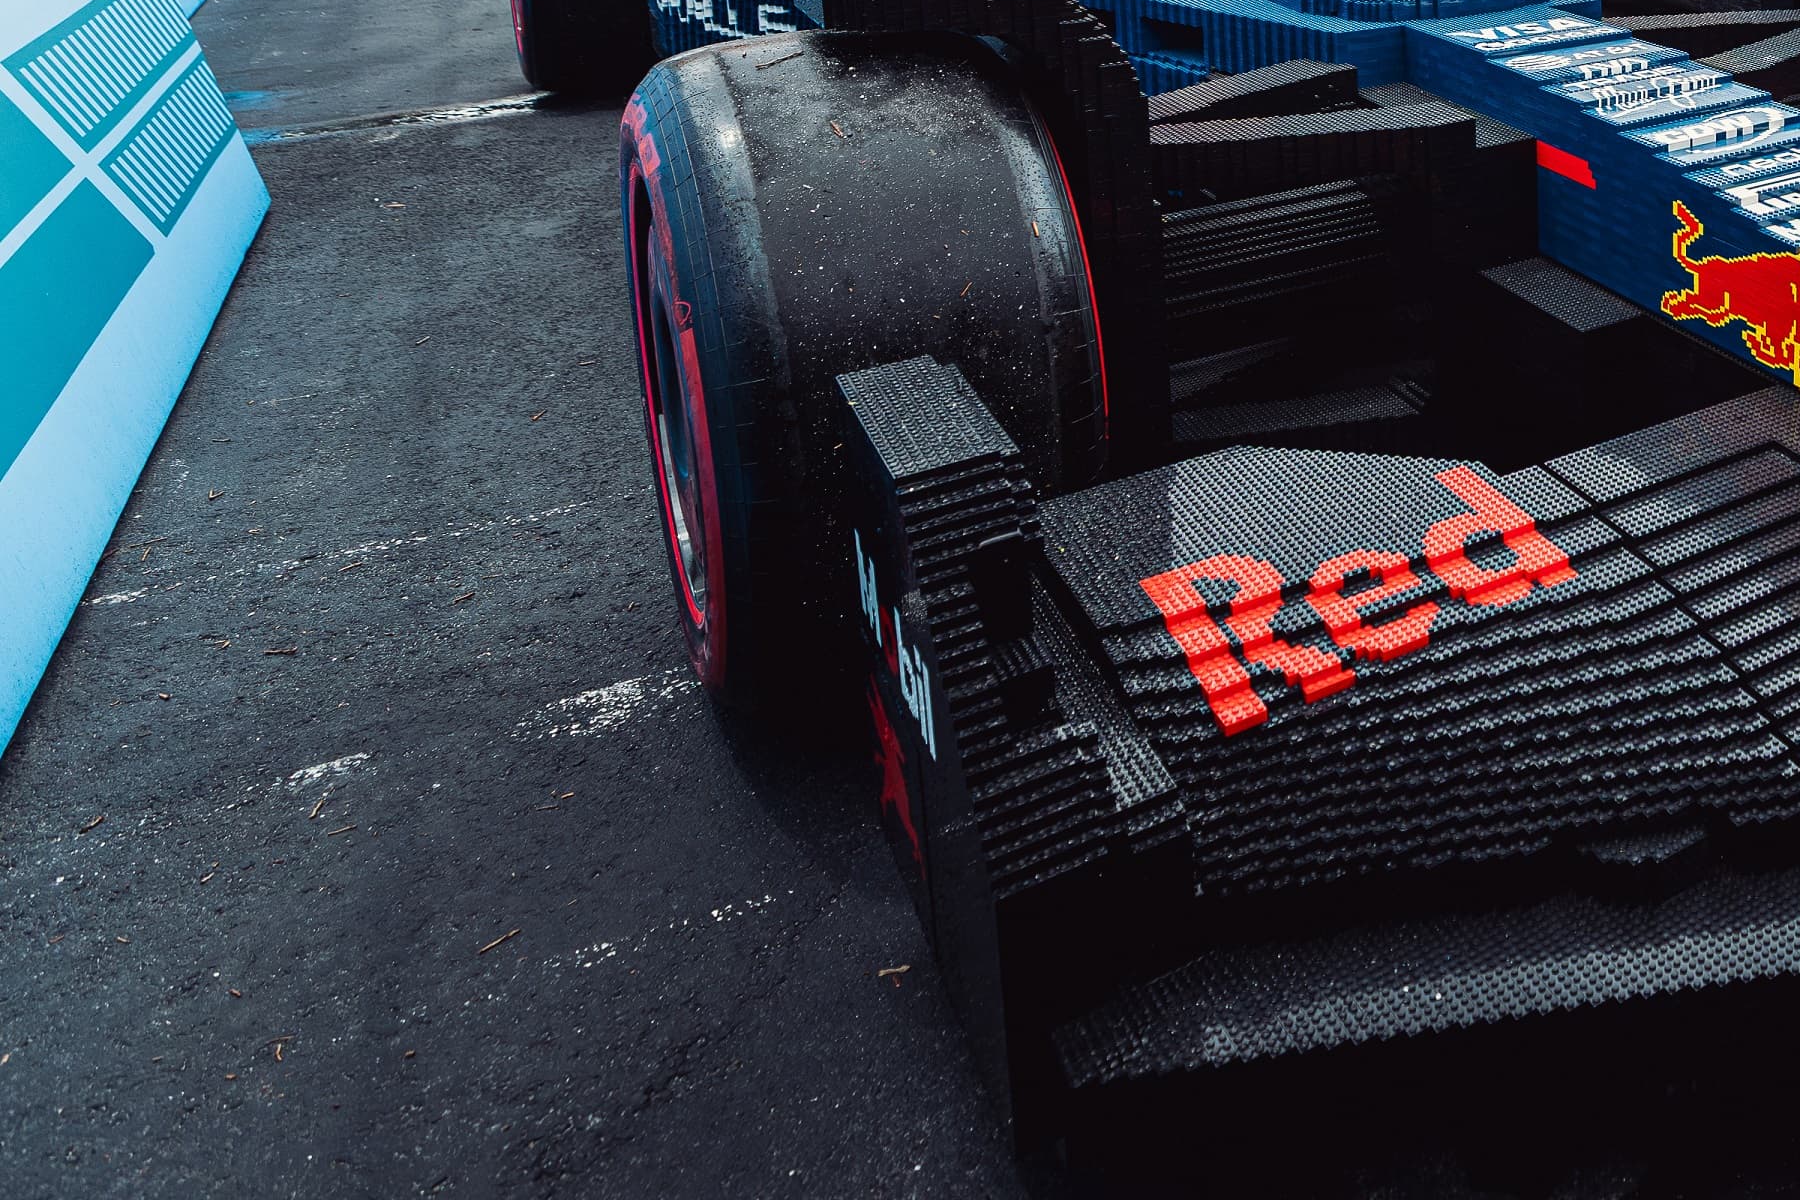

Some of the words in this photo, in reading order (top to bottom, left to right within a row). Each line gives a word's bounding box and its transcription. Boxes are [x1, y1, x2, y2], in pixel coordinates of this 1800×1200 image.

[1446, 16, 1597, 40] VISA
[853, 527, 938, 762] Mobil
[1138, 464, 1578, 736] Red
